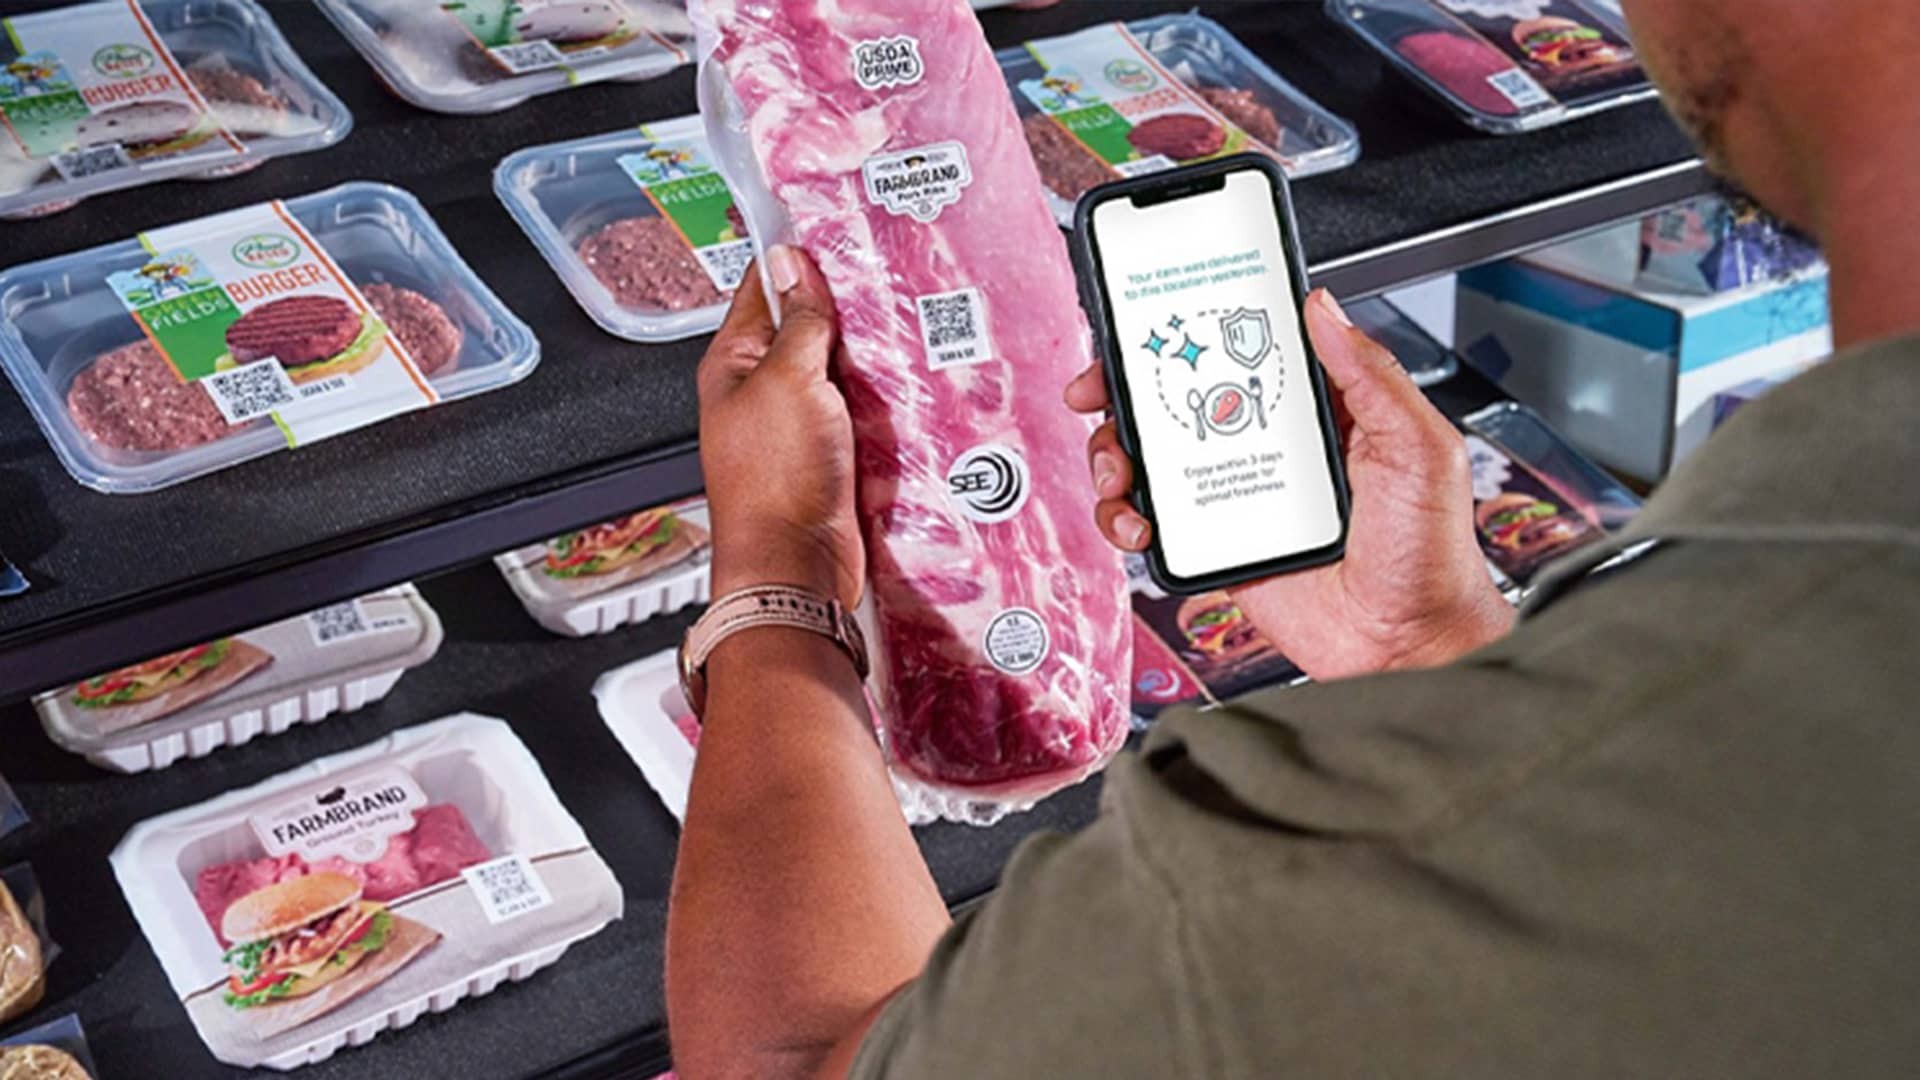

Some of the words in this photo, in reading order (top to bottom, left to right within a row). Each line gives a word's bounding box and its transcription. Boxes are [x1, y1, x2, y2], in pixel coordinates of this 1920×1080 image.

[861, 44, 910, 65] USDA
[83, 74, 170, 106] BURGER
[874, 163, 960, 195] FARMBRAND
[225, 262, 327, 303] BURGER
[151, 298, 231, 332] FIELDS
[1184, 466, 1213, 479] Enjoy
[1216, 458, 1247, 472] within
[1250, 453, 1257, 465] 3
[1259, 450, 1284, 465] days
[949, 470, 993, 496] SEE
[272, 785, 407, 845] FARMBRAND
